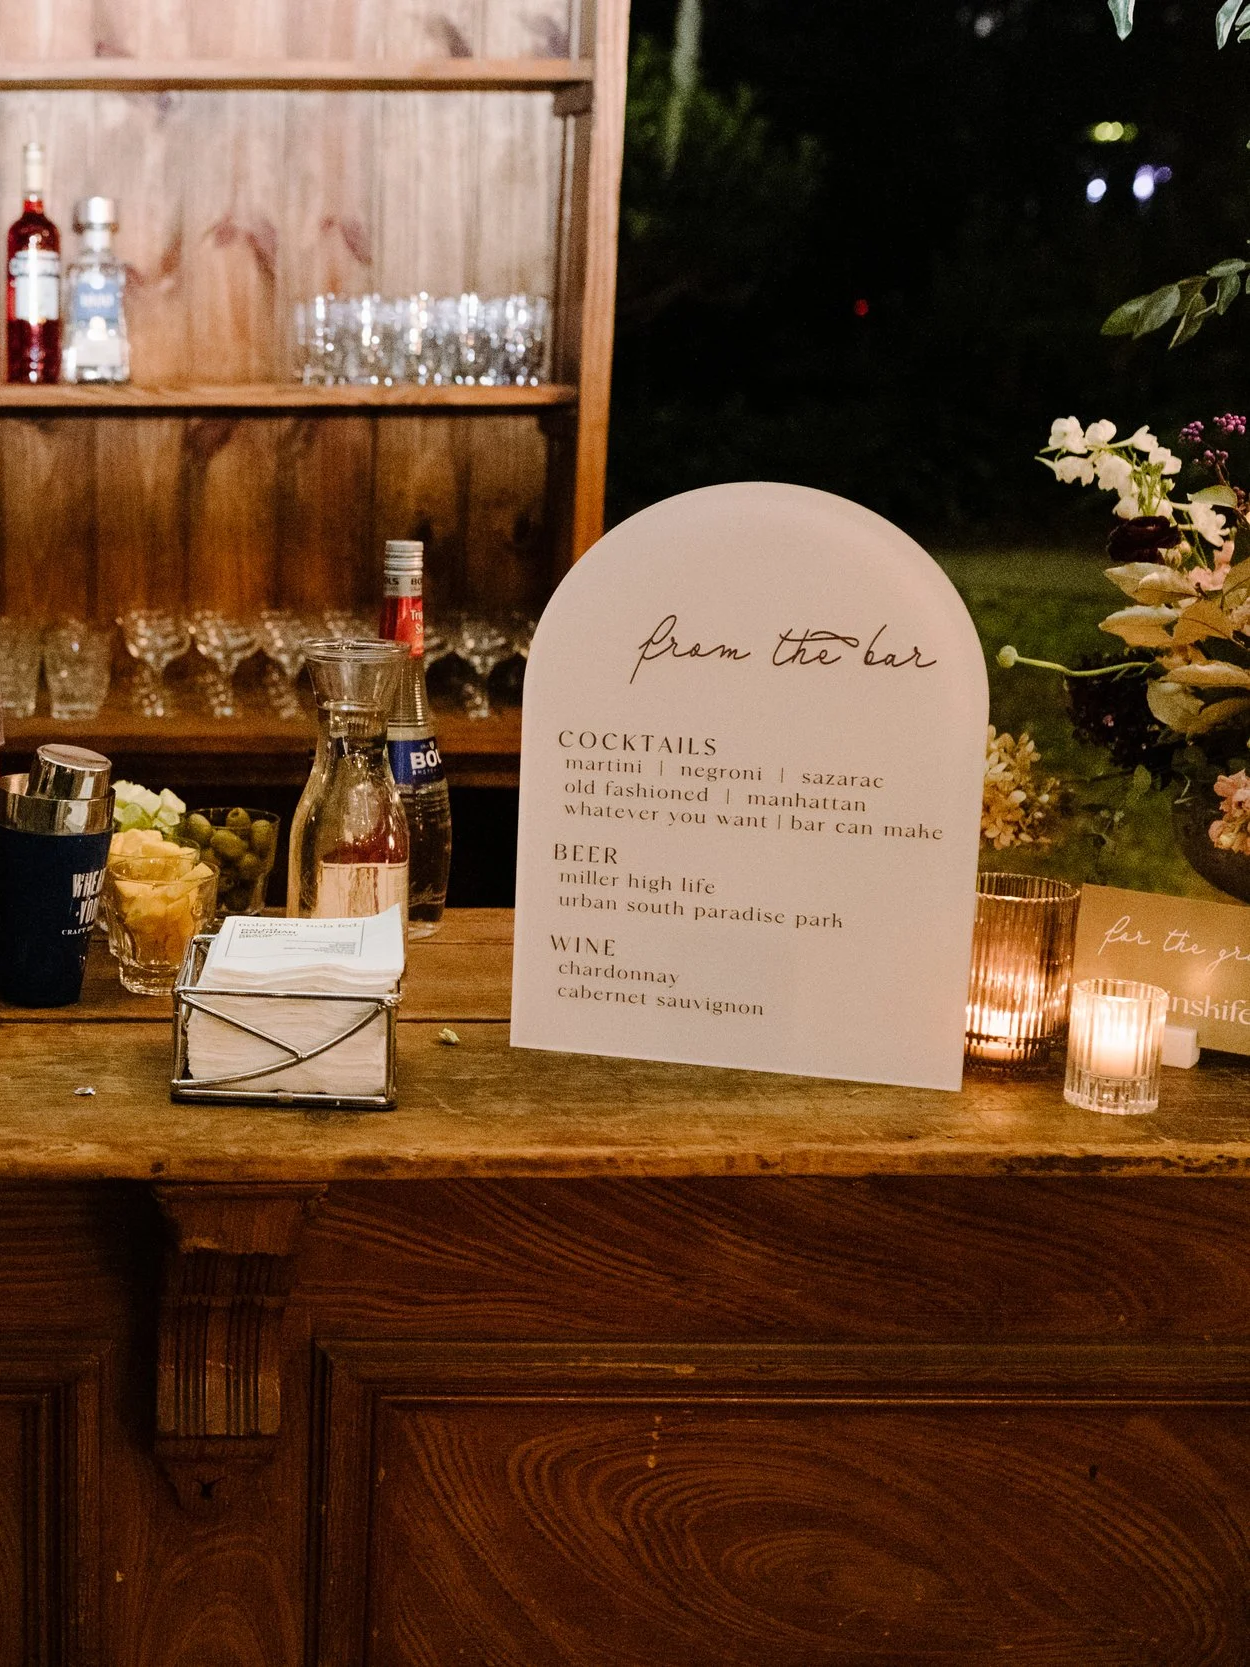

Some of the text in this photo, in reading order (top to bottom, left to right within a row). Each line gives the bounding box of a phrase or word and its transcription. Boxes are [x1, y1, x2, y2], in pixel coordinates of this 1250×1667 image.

[629, 614, 938, 685] from the bar
[558, 730, 717, 757] COCKTAILS
[566, 758, 642, 774] martini
[681, 765, 762, 783] negroni
[802, 772, 885, 789] sazarac
[565, 779, 595, 795] old
[606, 780, 709, 803] fashioned
[747, 792, 866, 813] manhattan
[565, 800, 660, 821] whatever
[668, 811, 707, 827] you
[716, 814, 768, 830] want
[791, 815, 826, 833] bar
[835, 822, 873, 836] can
[883, 823, 945, 841] make
[554, 843, 619, 865] BEER
[560, 869, 717, 896] miller high life
[559, 893, 843, 930] urban south paradise park
[61, 926, 88, 936] CRAFT
[550, 934, 616, 957] WINE
[1098, 915, 1150, 955] for
[1163, 929, 1206, 954] the
[558, 960, 680, 989] chardonnay
[557, 985, 765, 1017] cabernet sauvignon
